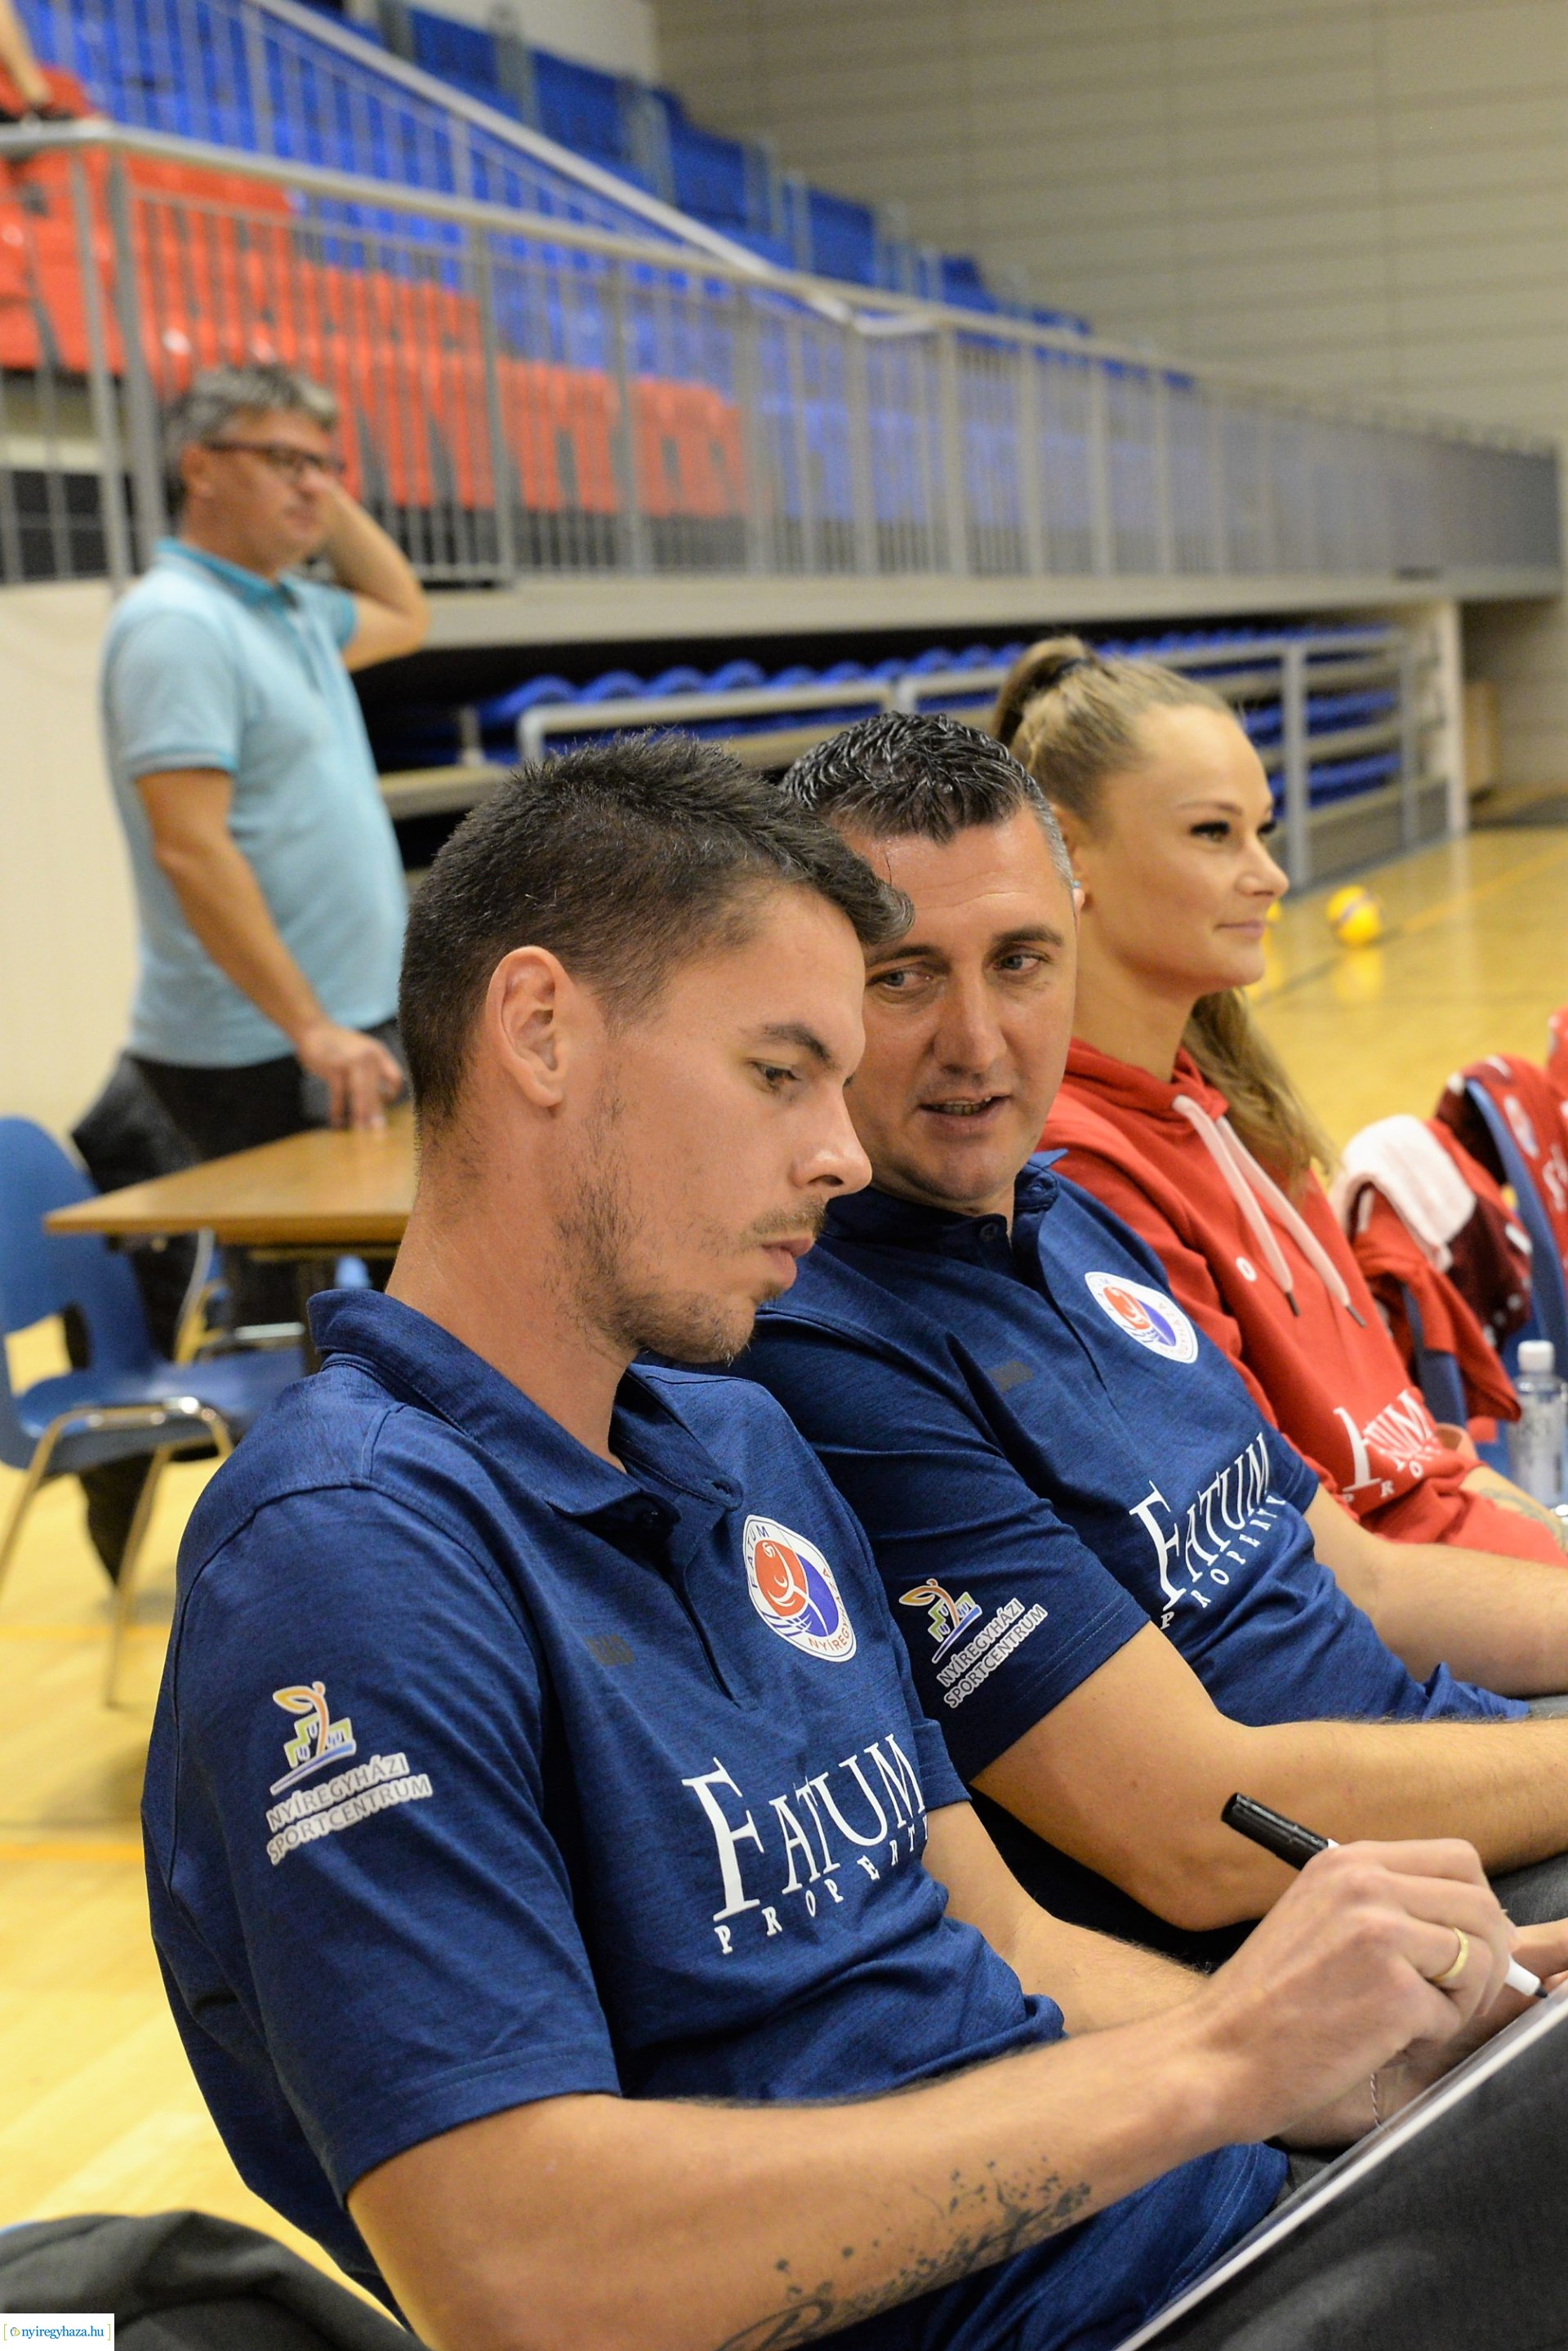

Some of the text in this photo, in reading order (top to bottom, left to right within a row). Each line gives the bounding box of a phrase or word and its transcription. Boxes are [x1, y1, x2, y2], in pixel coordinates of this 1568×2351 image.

[746, 1524, 770, 1589] FATUM
[1129, 1432, 1270, 1612] FATUM
[1160, 1495, 1286, 1630] PROPERTY
[938, 1598, 1024, 1686] NYÍREGYHÁZI
[945, 1605, 1047, 1708] SPORTCENTRUM
[267, 1753, 409, 1832] NYÍREGYHÁZI
[267, 1775, 432, 1864] SPORTCENTRUM
[681, 1733, 925, 1922] FATUM
